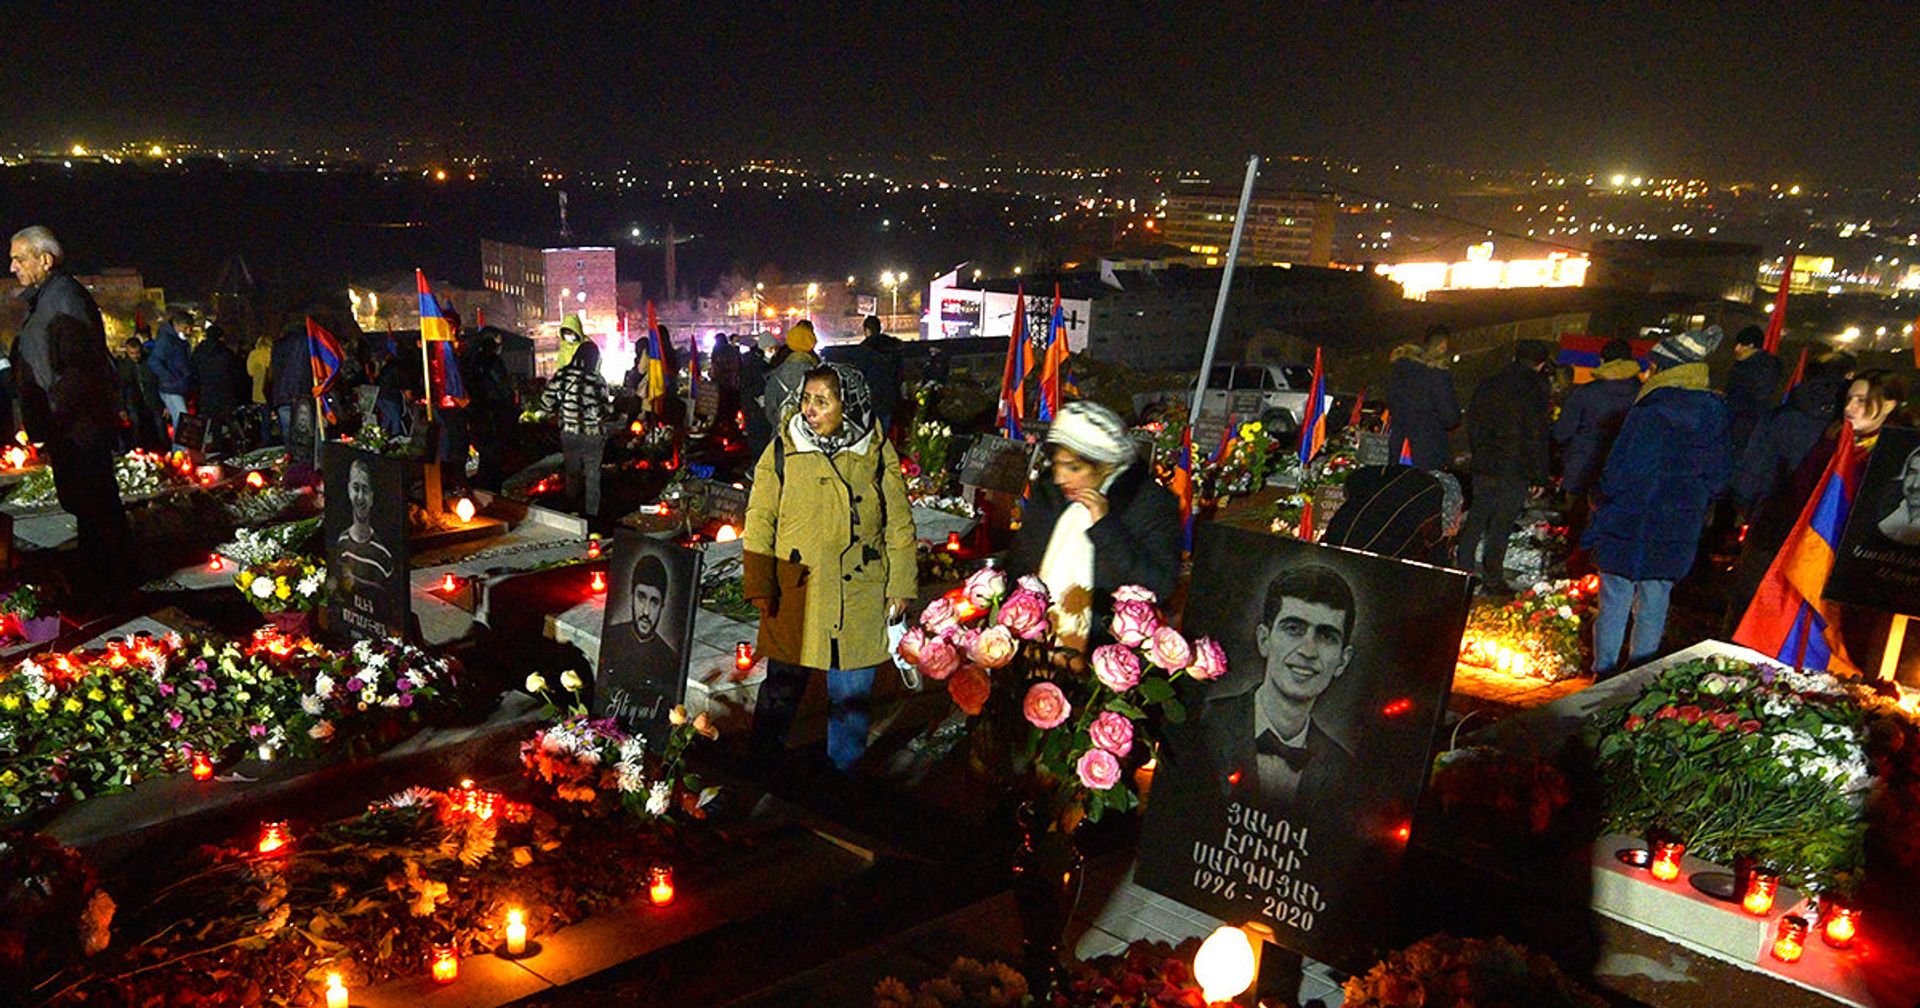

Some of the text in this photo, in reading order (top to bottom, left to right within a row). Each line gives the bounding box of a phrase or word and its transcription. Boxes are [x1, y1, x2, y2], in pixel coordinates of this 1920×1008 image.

[1224, 827, 1301, 873] ԷՐԻԿԻ
[1227, 802, 1309, 857] ՅԱԿՈՎ
[1193, 841, 1327, 913] ՍԱՐԳՍՅԱՆ
[1193, 868, 1237, 900] 1996
[1261, 895, 1315, 932] 2020
